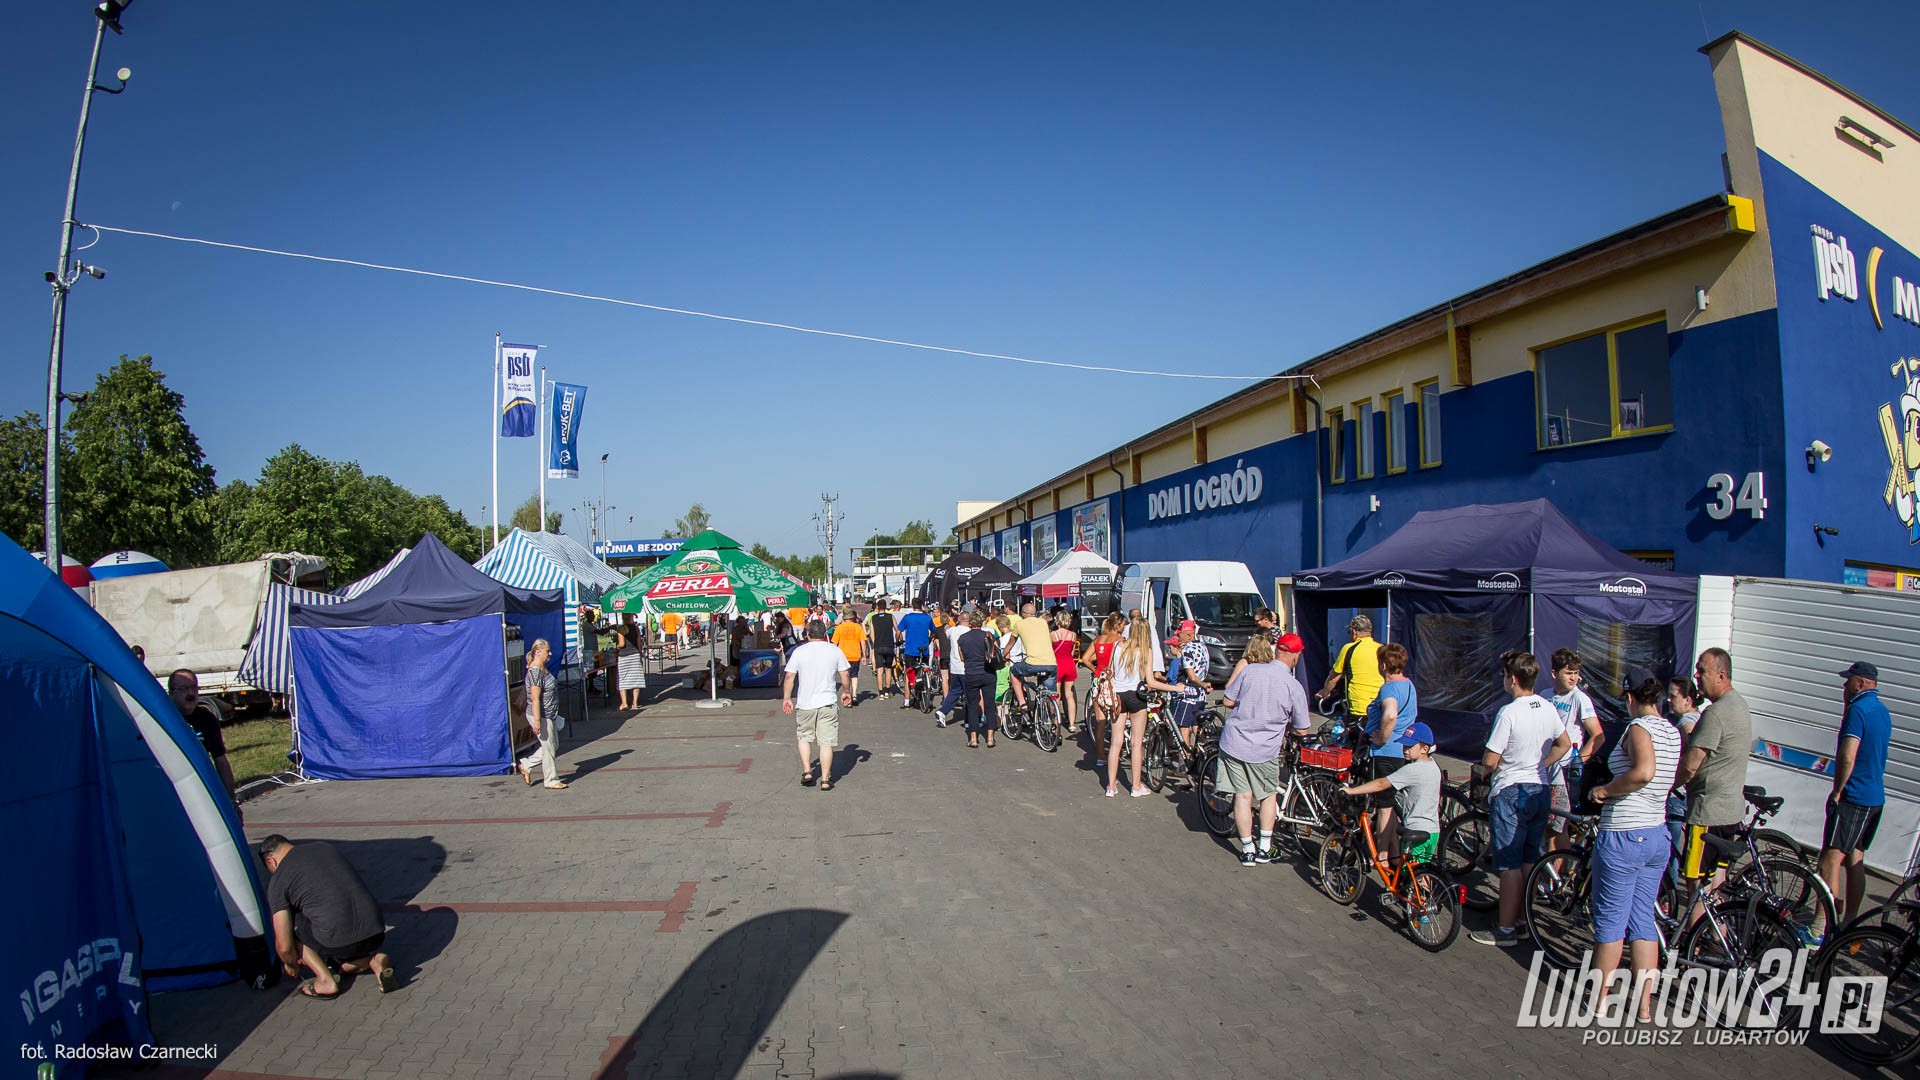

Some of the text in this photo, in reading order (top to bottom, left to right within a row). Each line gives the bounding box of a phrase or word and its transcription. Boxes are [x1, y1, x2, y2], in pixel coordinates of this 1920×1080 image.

[1812, 235, 1920, 327] psb M
[507, 352, 530, 379] psb
[1148, 459, 1263, 521] DOM I OGRÓD
[1706, 472, 1767, 520] 34
[652, 576, 730, 594] PERŁA
[1477, 579, 1518, 589] Mostostal
[1599, 582, 1644, 594] Mostostal
